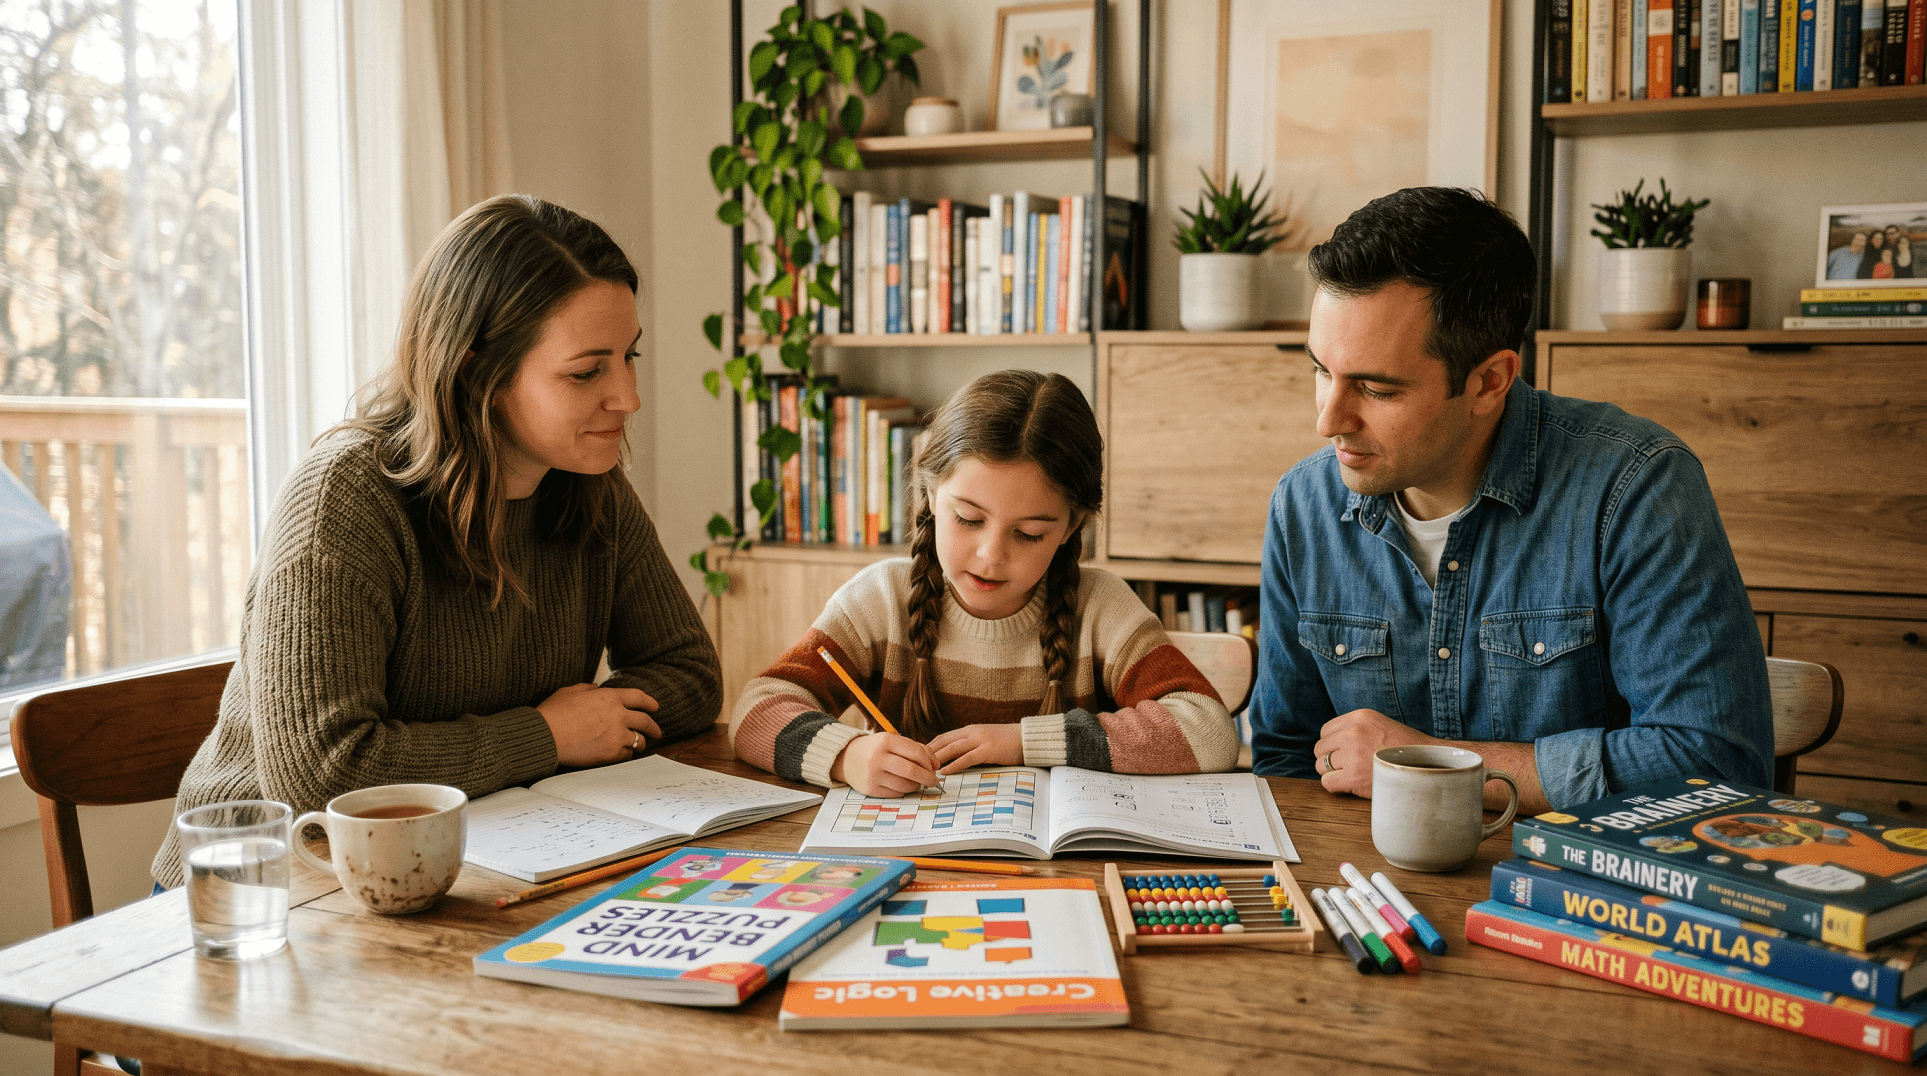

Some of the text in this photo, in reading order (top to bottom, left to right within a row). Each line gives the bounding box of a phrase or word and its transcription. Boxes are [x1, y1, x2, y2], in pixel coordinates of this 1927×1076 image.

[1591, 784, 1750, 830] BRAINERY
[1622, 795, 1657, 806] THE
[1562, 845, 1587, 866] THE
[1592, 849, 1699, 900] BRAINERY
[601, 906, 792, 930] PUZZLES
[1563, 890, 1667, 938] WORLD
[1673, 921, 1771, 967] ATLAS
[576, 921, 766, 946] BENDER
[583, 940, 715, 961] MIND
[813, 982, 1096, 1003] Creative Logic
[1561, 941, 1805, 1029] MATH ADVENTURES
